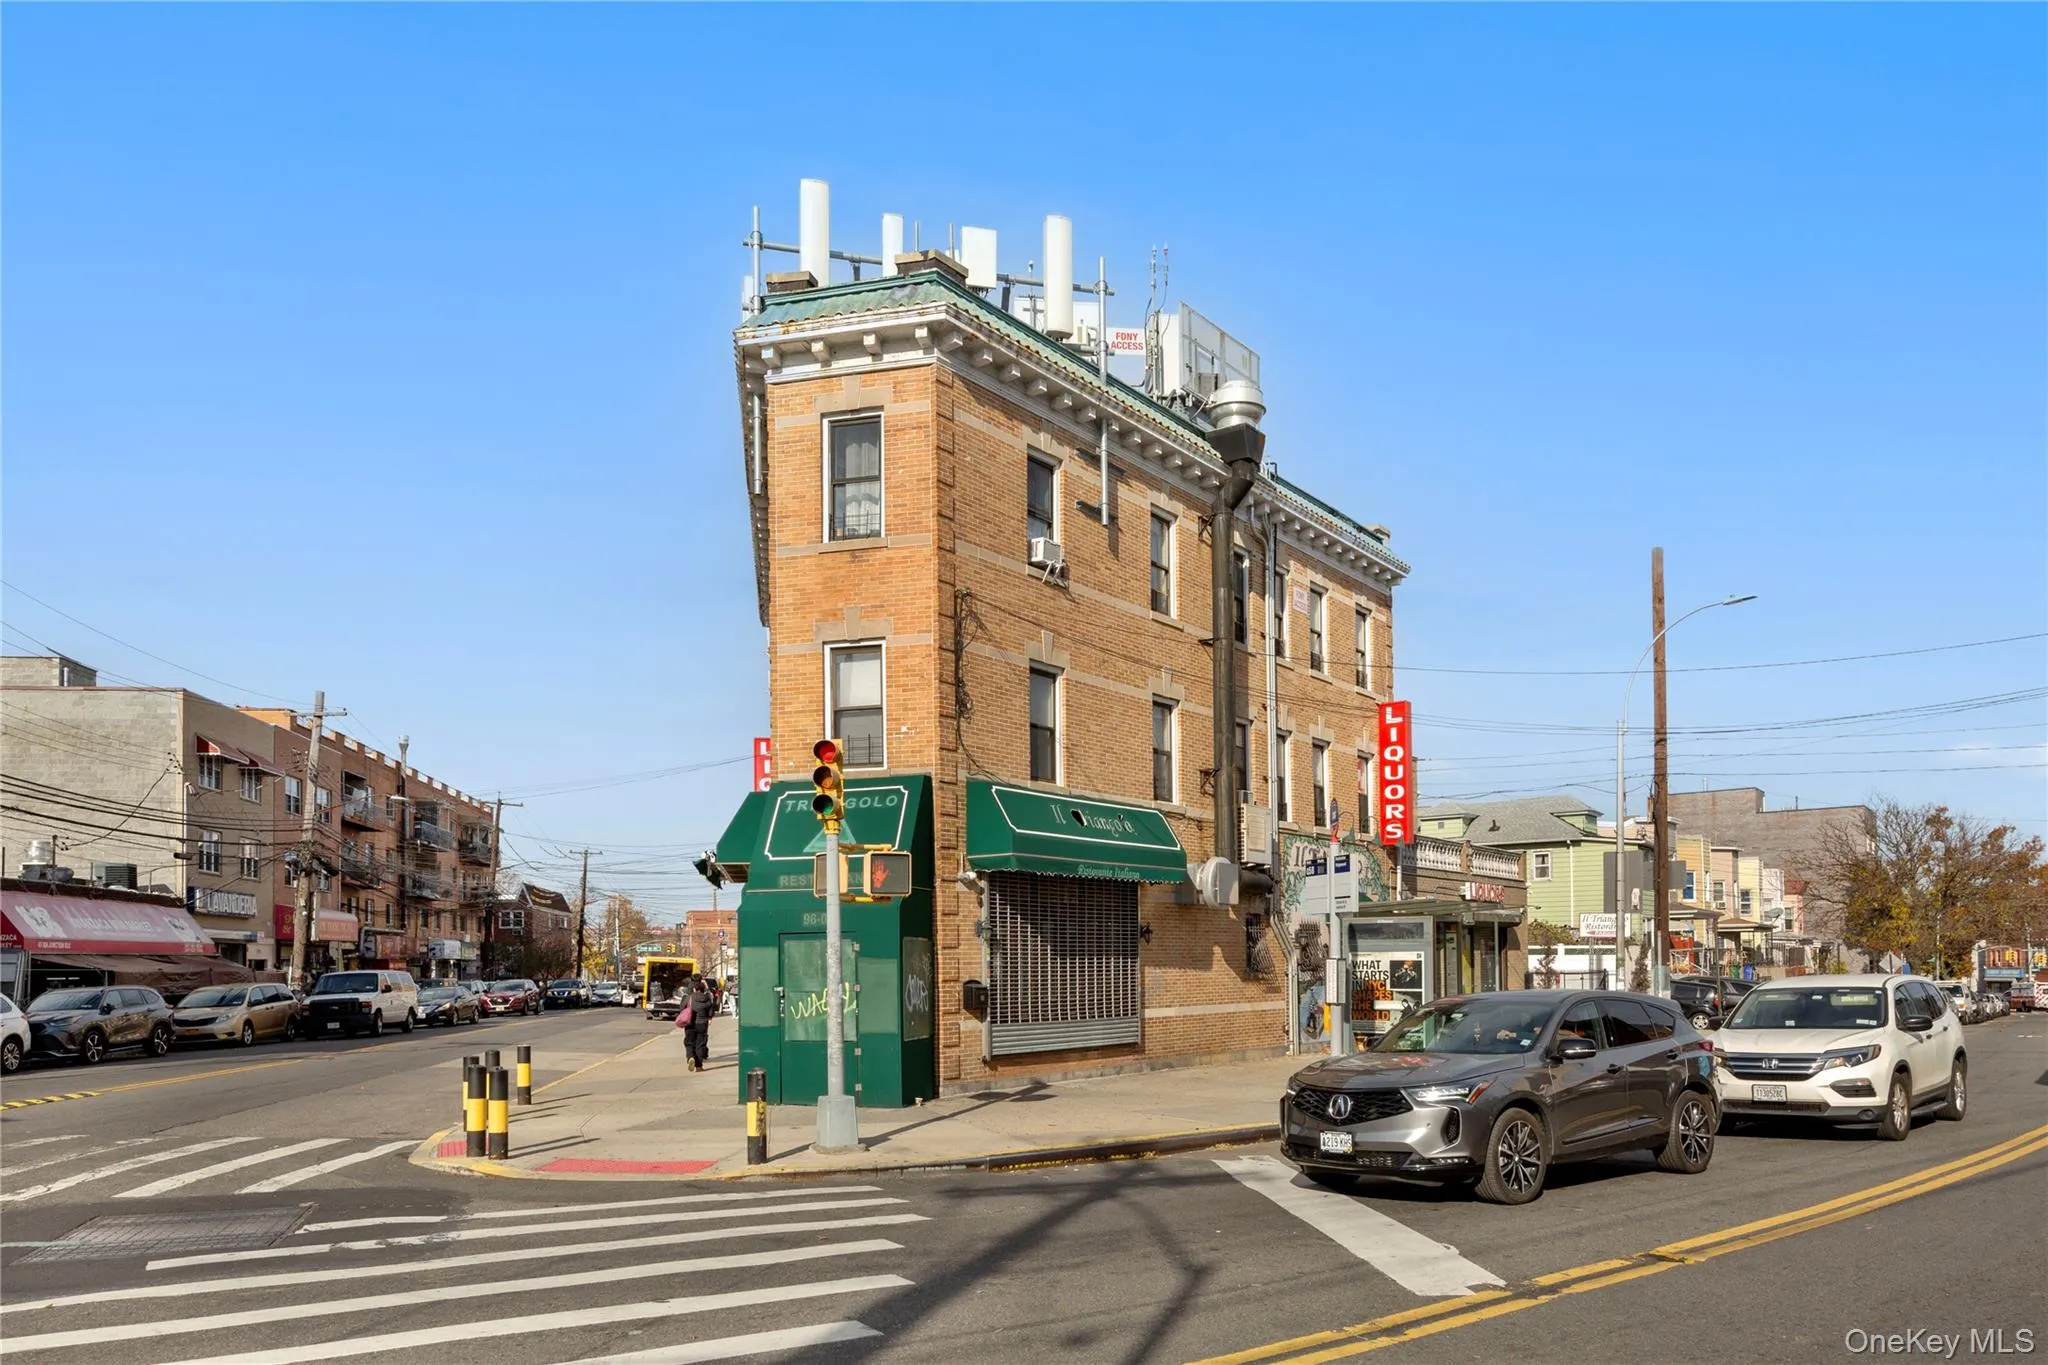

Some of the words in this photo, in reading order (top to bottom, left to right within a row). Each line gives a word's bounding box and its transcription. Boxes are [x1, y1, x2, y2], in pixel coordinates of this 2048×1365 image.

[1115, 332, 1138, 341] FDNY
[1110, 341, 1144, 351] ACCESS
[1384, 706, 1405, 839] LIQUORS
[785, 795, 898, 813] TRGOLO
[207, 891, 258, 916] LAVANDERIA
[1352, 960, 1381, 970] WHAT
[1352, 970, 1389, 981] STARTS
[1352, 981, 1362, 991] IN
[1352, 991, 1393, 1001] SHAPES
[1352, 1001, 1371, 1010] THE
[1352, 1010, 1390, 1021] WORLD
